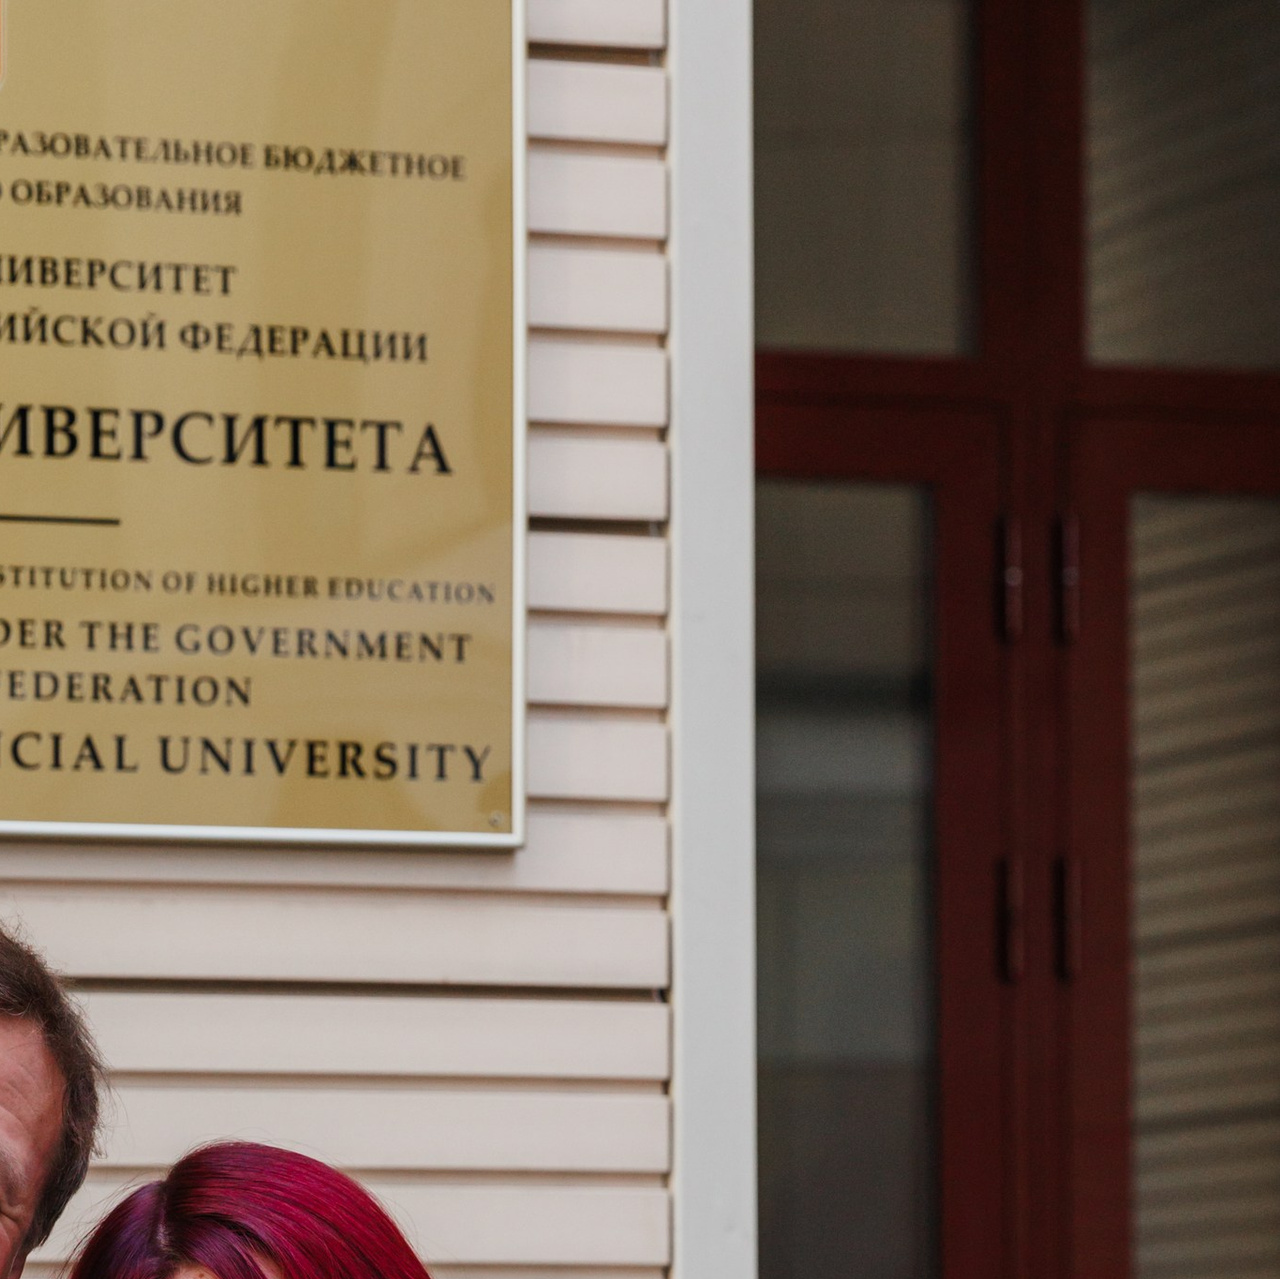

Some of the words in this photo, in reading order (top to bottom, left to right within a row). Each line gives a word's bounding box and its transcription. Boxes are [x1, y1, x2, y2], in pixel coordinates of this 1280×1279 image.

[262, 144, 465, 180] БЮДЖЕТНОЕ
[9, 179, 244, 216] ОБРАЗОВАНИЯ
[178, 322, 429, 363] ФЕДЕРАЦИИ
[160, 571, 199, 594] OF
[206, 573, 320, 598] HIGHER
[326, 577, 497, 604] EDUCATION
[79, 621, 160, 652] THE
[174, 624, 473, 664] GOVERNMENT
[158, 736, 491, 782] UNIVERSITY
